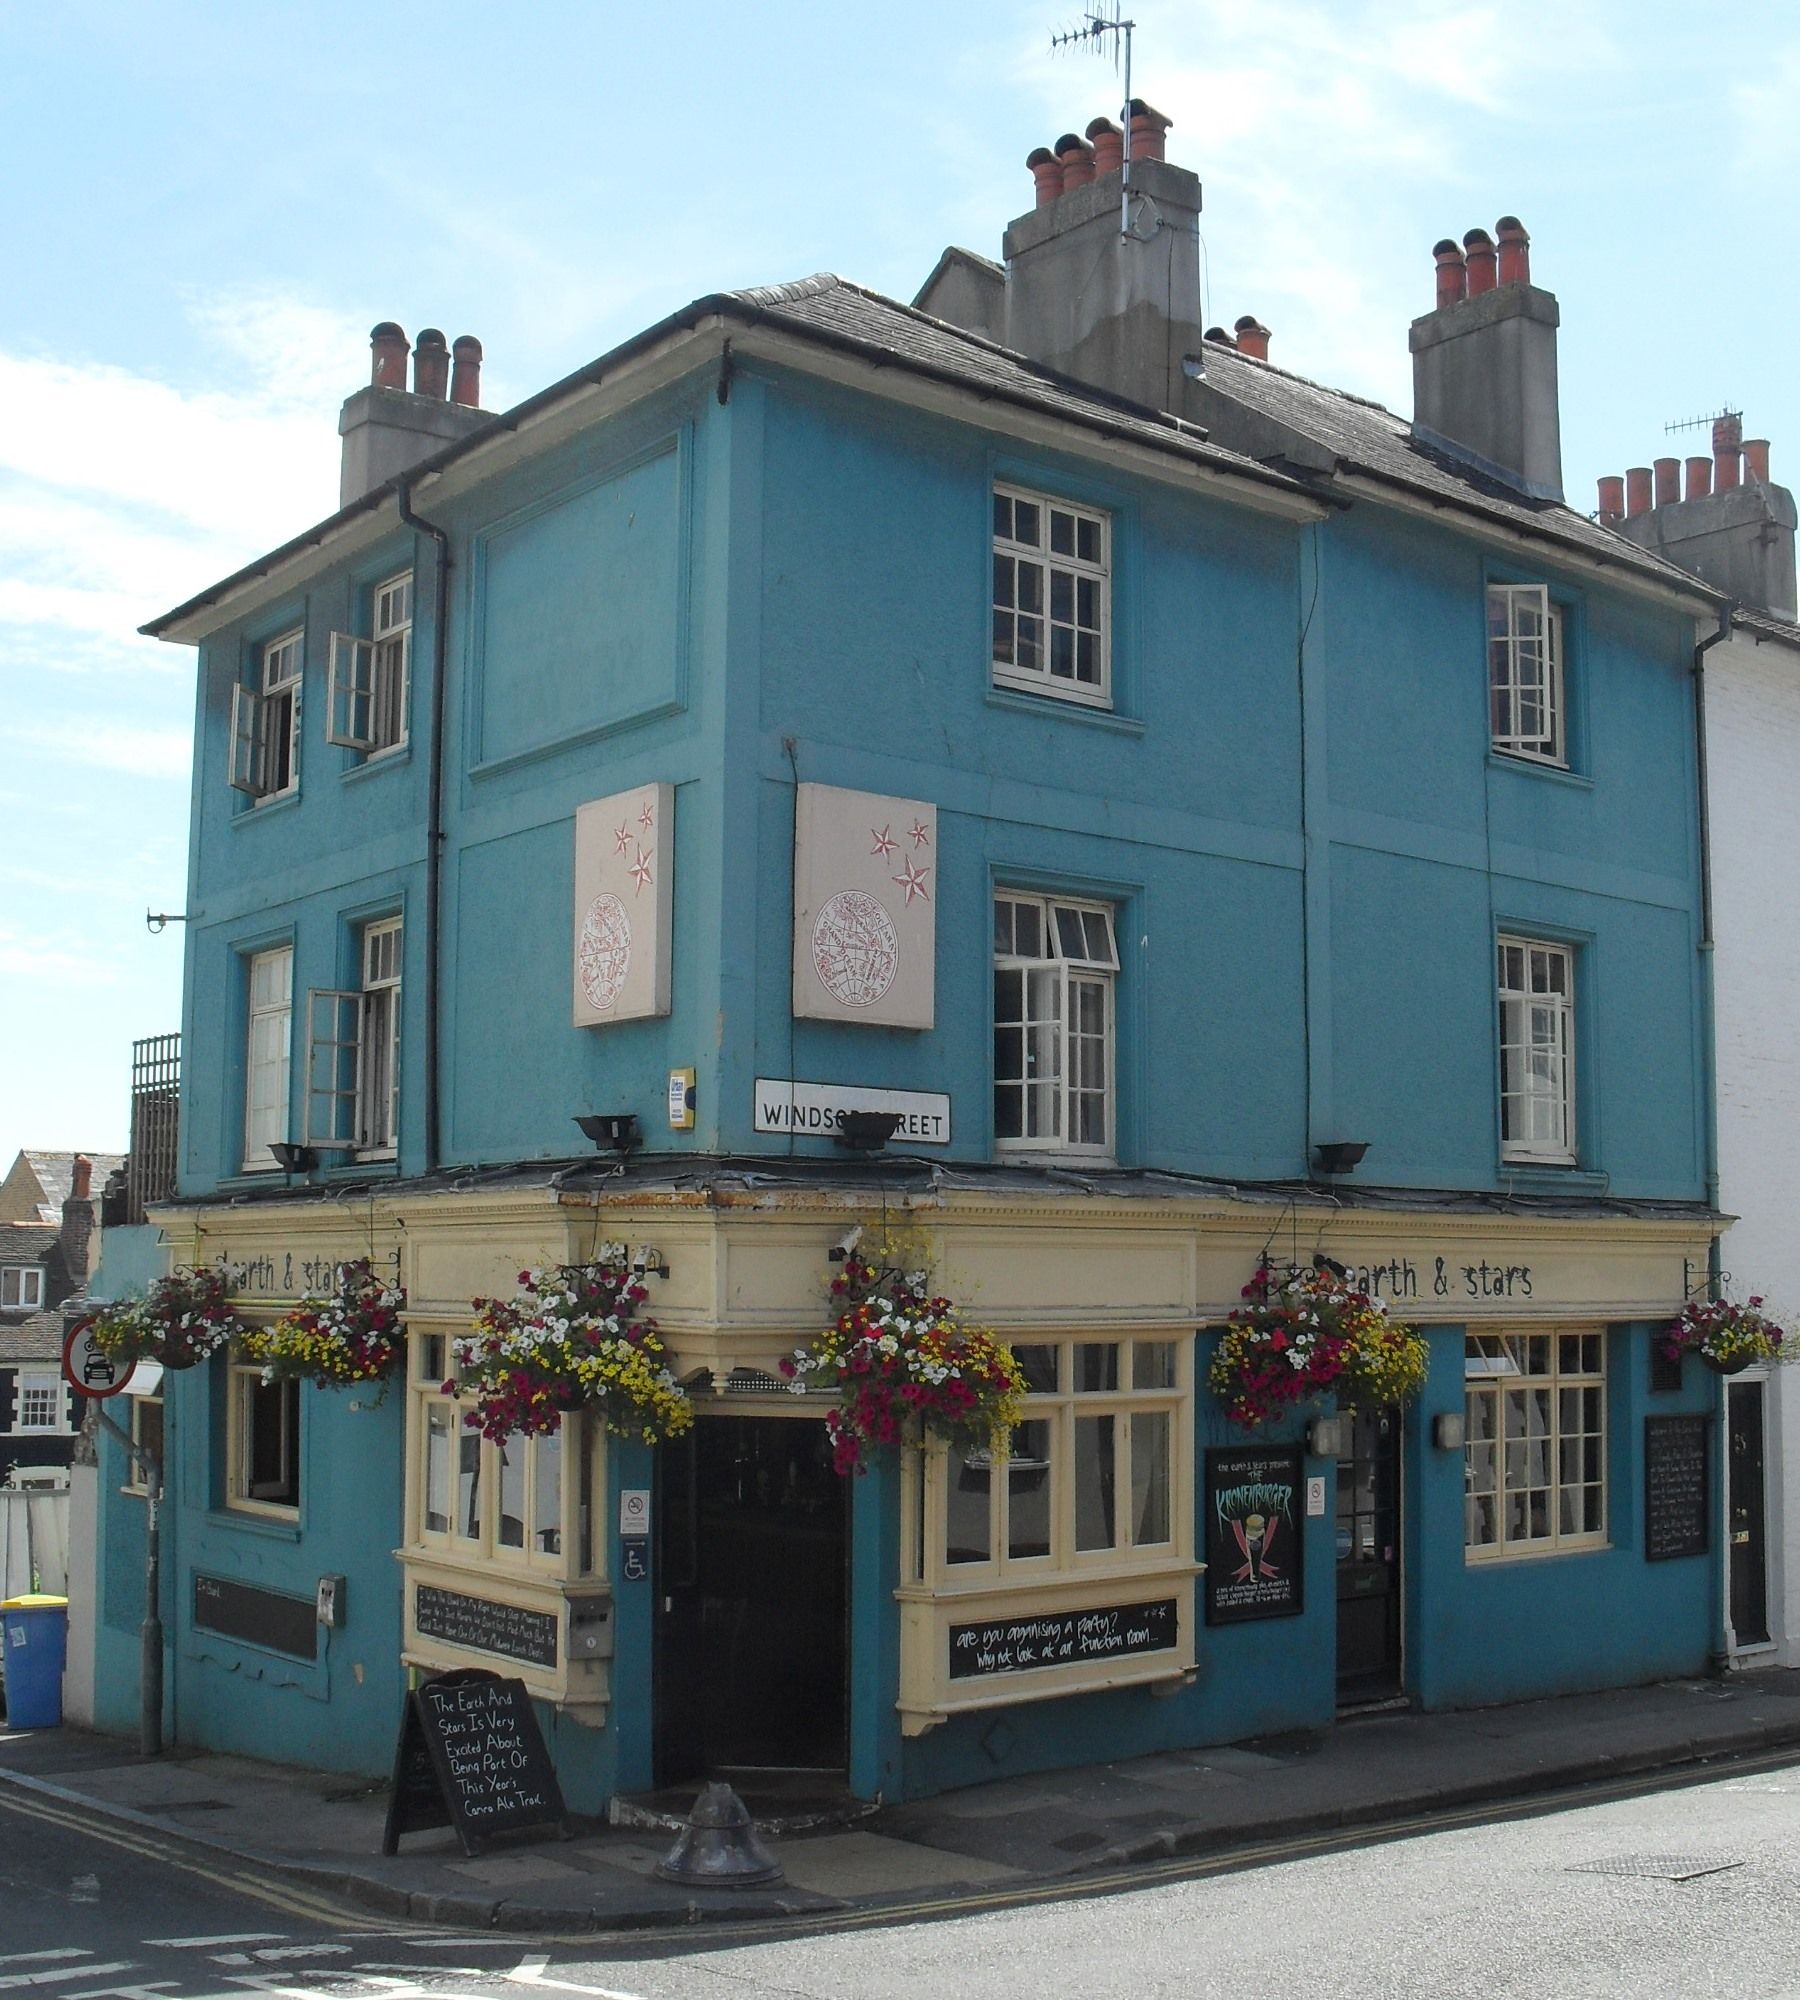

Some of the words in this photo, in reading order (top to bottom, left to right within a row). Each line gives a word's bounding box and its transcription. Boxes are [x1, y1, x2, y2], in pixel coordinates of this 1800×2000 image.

[763, 1103, 859, 1131] WINDSO
[876, 1112, 942, 1136] REET
[284, 1252, 293, 1291] &
[1350, 1257, 1420, 1297] arth
[1434, 1256, 1448, 1296] &
[1460, 1258, 1533, 1299] stars
[956, 1631, 979, 1649] are
[983, 1628, 1004, 1651] you
[1064, 1619, 1073, 1635] a
[976, 1649, 996, 1672] why
[1016, 1644, 1038, 1664] look
[1041, 1643, 1054, 1660] at
[1079, 1632, 1123, 1653] function
[429, 1693, 454, 1713] The
[458, 1691, 485, 1712] Earth
[488, 1687, 513, 1706] And
[438, 1718, 466, 1736] Stars
[467, 1713, 485, 1732] Is
[486, 1710, 515, 1731] Very
[445, 1740, 481, 1759] Excited
[486, 1733, 523, 1751] About
[451, 1758, 480, 1776] Being
[483, 1753, 506, 1771] Part
[510, 1750, 528, 1769] Of
[456, 1778, 484, 1795] This
[485, 1773, 517, 1793] Year's
[496, 1796, 515, 1812] Ale
